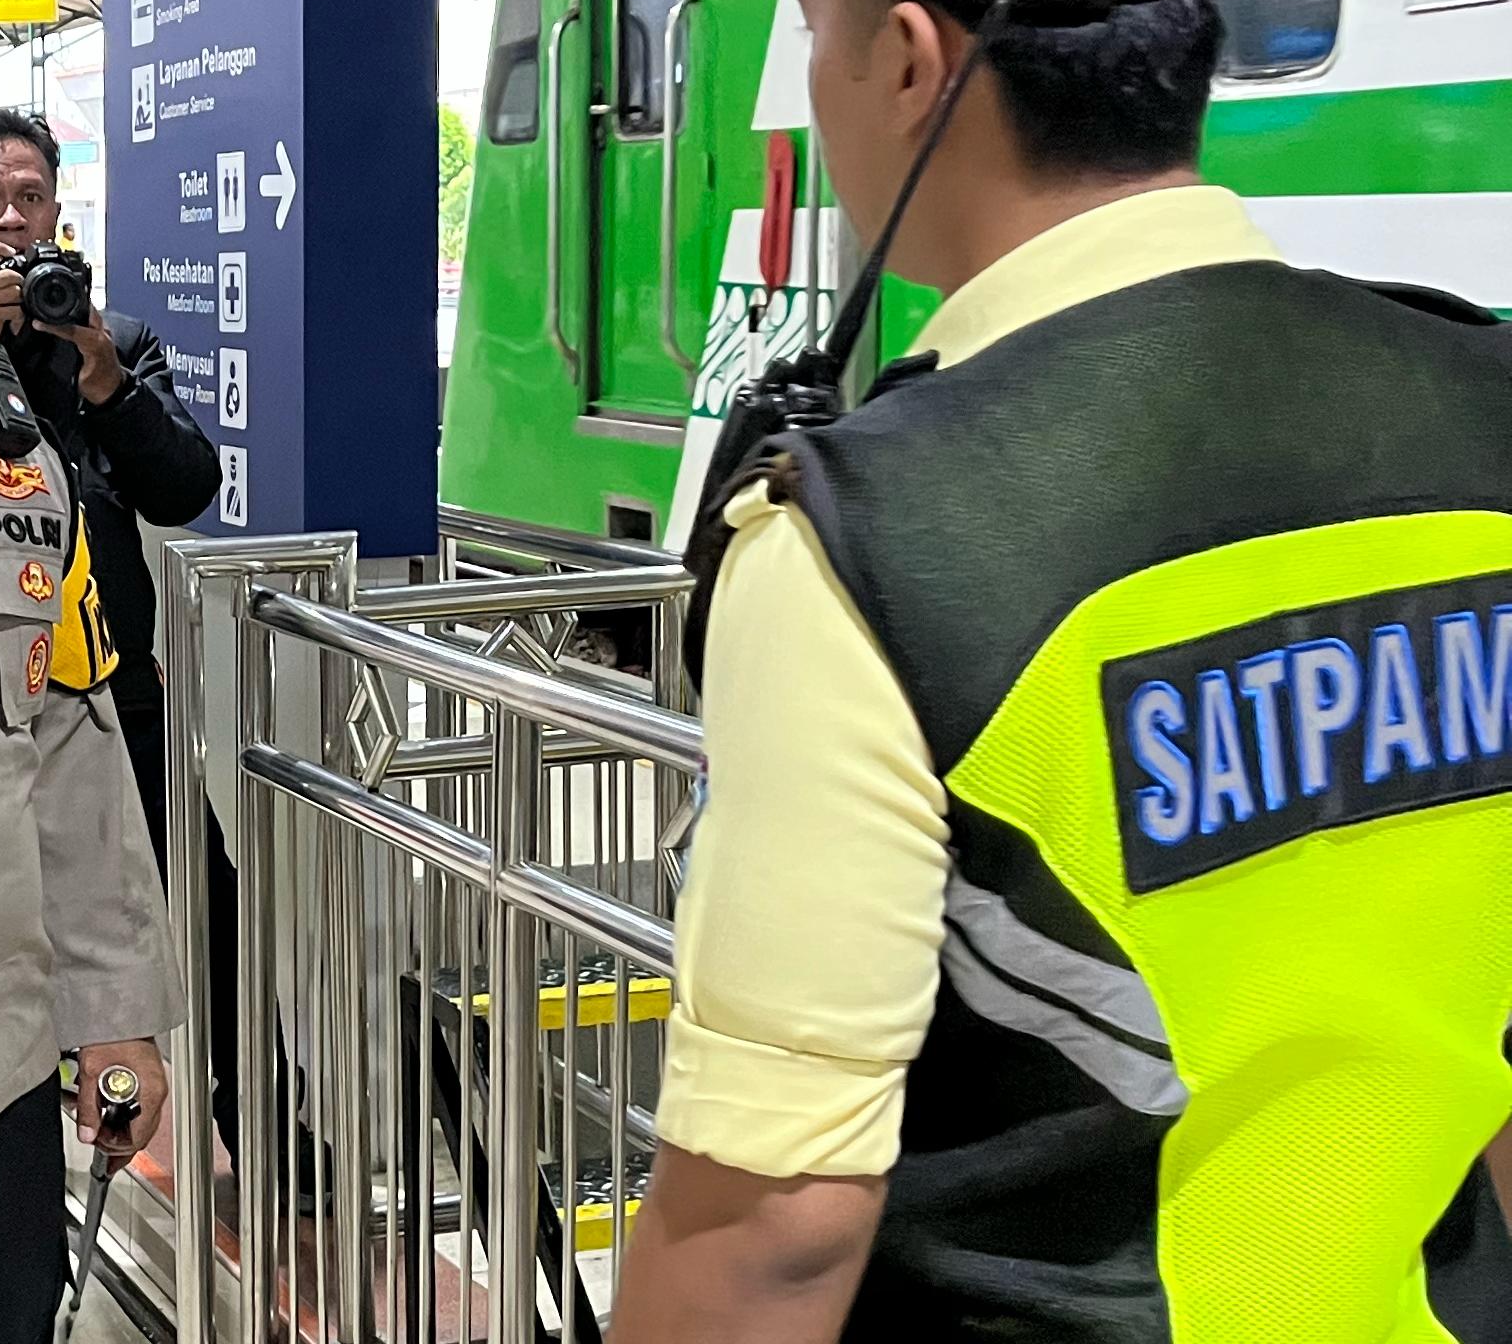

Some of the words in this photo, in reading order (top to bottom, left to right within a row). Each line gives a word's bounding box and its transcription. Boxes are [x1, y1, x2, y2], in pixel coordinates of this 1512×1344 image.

[159, 59, 201, 89] Layanan
[201, 44, 256, 76] Pelanggan
[178, 169, 209, 198] Toilet
[143, 257, 161, 283] Pos
[161, 257, 215, 284] Kesehatan
[165, 344, 215, 379] Menyusui
[1126, 604, 1512, 847] SATPAM
